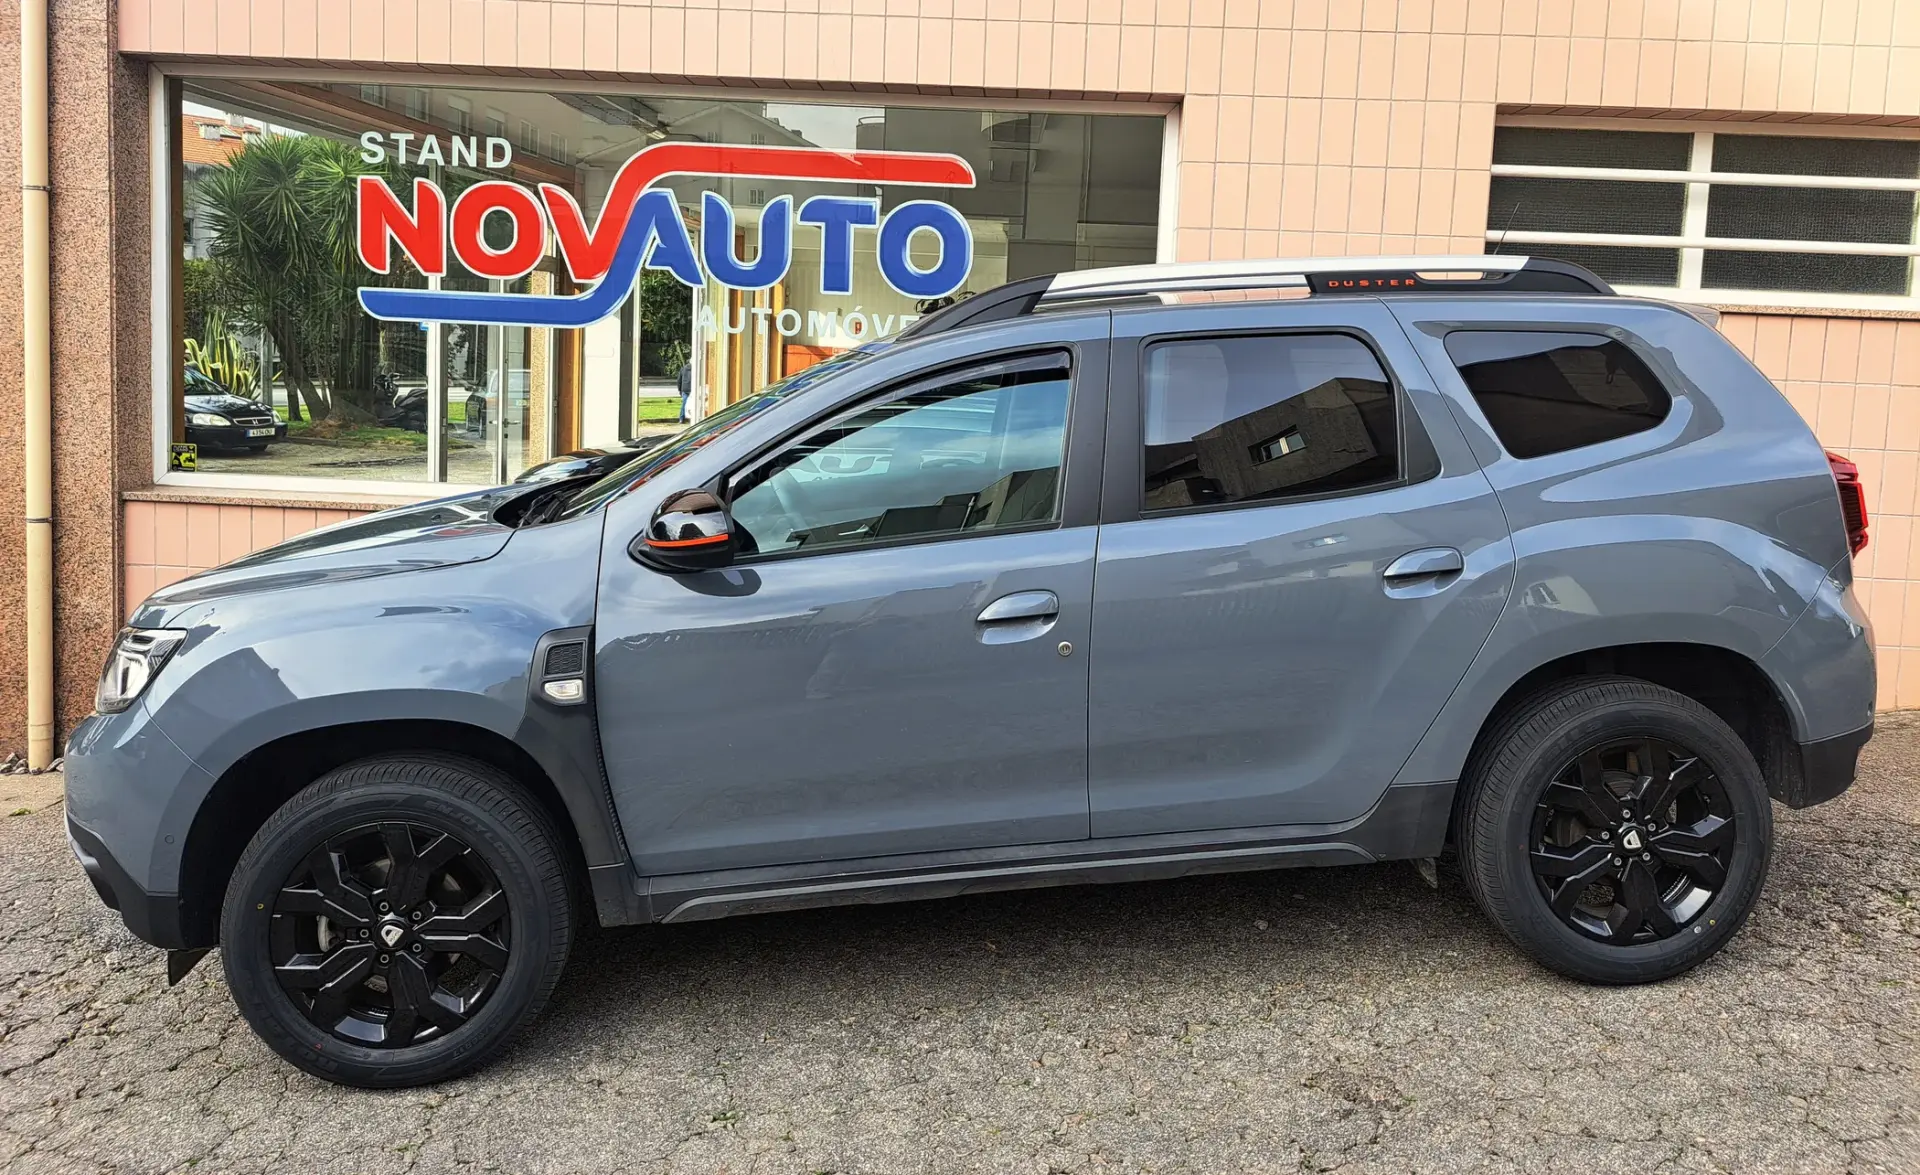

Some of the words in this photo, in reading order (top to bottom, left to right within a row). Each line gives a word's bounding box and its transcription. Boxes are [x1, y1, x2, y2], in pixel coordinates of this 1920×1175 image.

[360, 131, 513, 169] STAND
[357, 165, 976, 300] NOVAUTO
[1329, 279, 1415, 288] DUSTER
